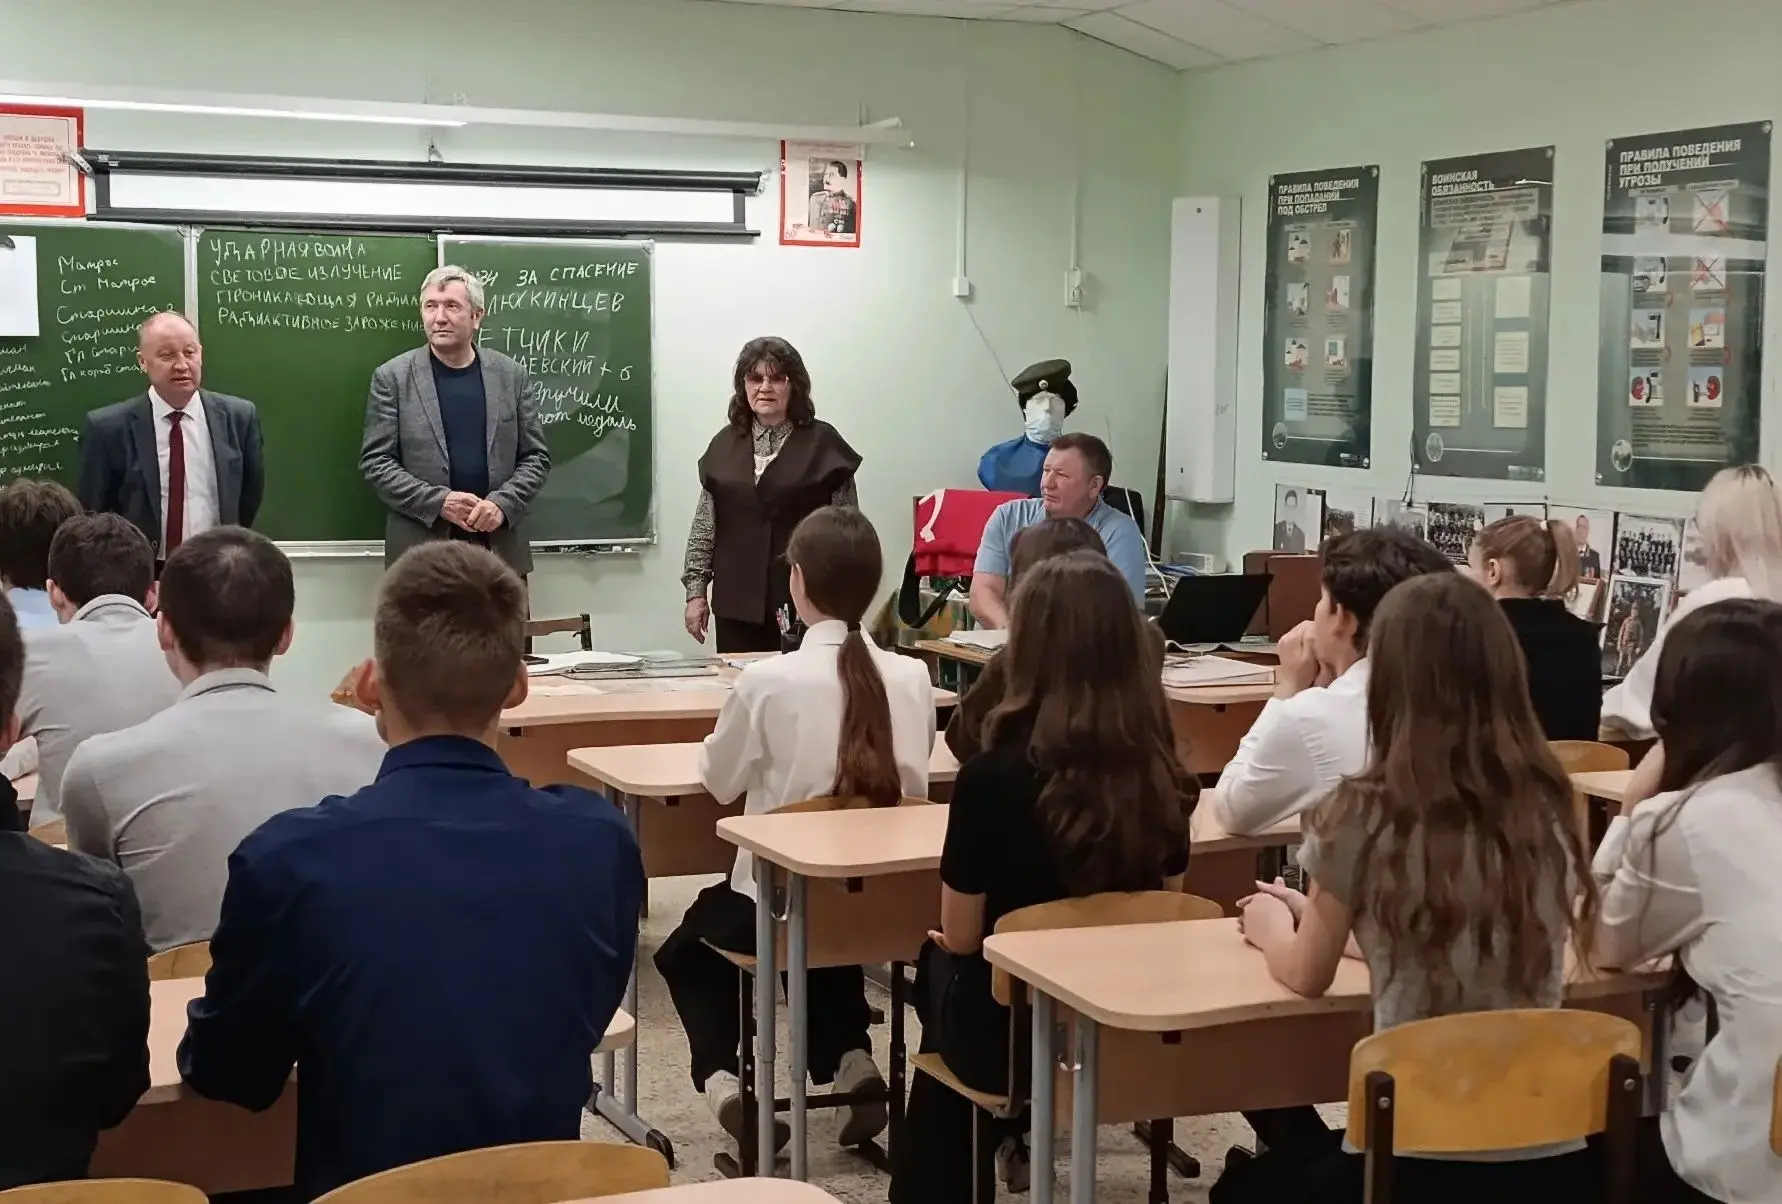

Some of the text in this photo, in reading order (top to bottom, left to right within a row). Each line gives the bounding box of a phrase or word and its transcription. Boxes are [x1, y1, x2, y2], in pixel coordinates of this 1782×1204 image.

[1620, 139, 1742, 163] ПРАВИЛА ПОВЕДЕНИЯ
[1620, 155, 1710, 176] ПРИ ПОЛУЧЕНИИ
[1432, 170, 1478, 185] ВОИНСКАЯ
[1619, 174, 1662, 189] УГРОЗЫ
[1278, 179, 1359, 194] ПРАВИЛА ПОВЕДЕНИЯ
[1432, 180, 1495, 196] ОБЯЗАННОСТЬ
[1278, 191, 1340, 205] ПРИ ПОПАДАНИИ
[1277, 202, 1327, 216] ПОД ОБСТРЕЛ
[211, 263, 402, 285] СВЕТОВОЕ ИЗЛУЧЕНИЕ
[516, 270, 538, 287] ЗА
[550, 261, 640, 281] СПАСЕНИЕ
